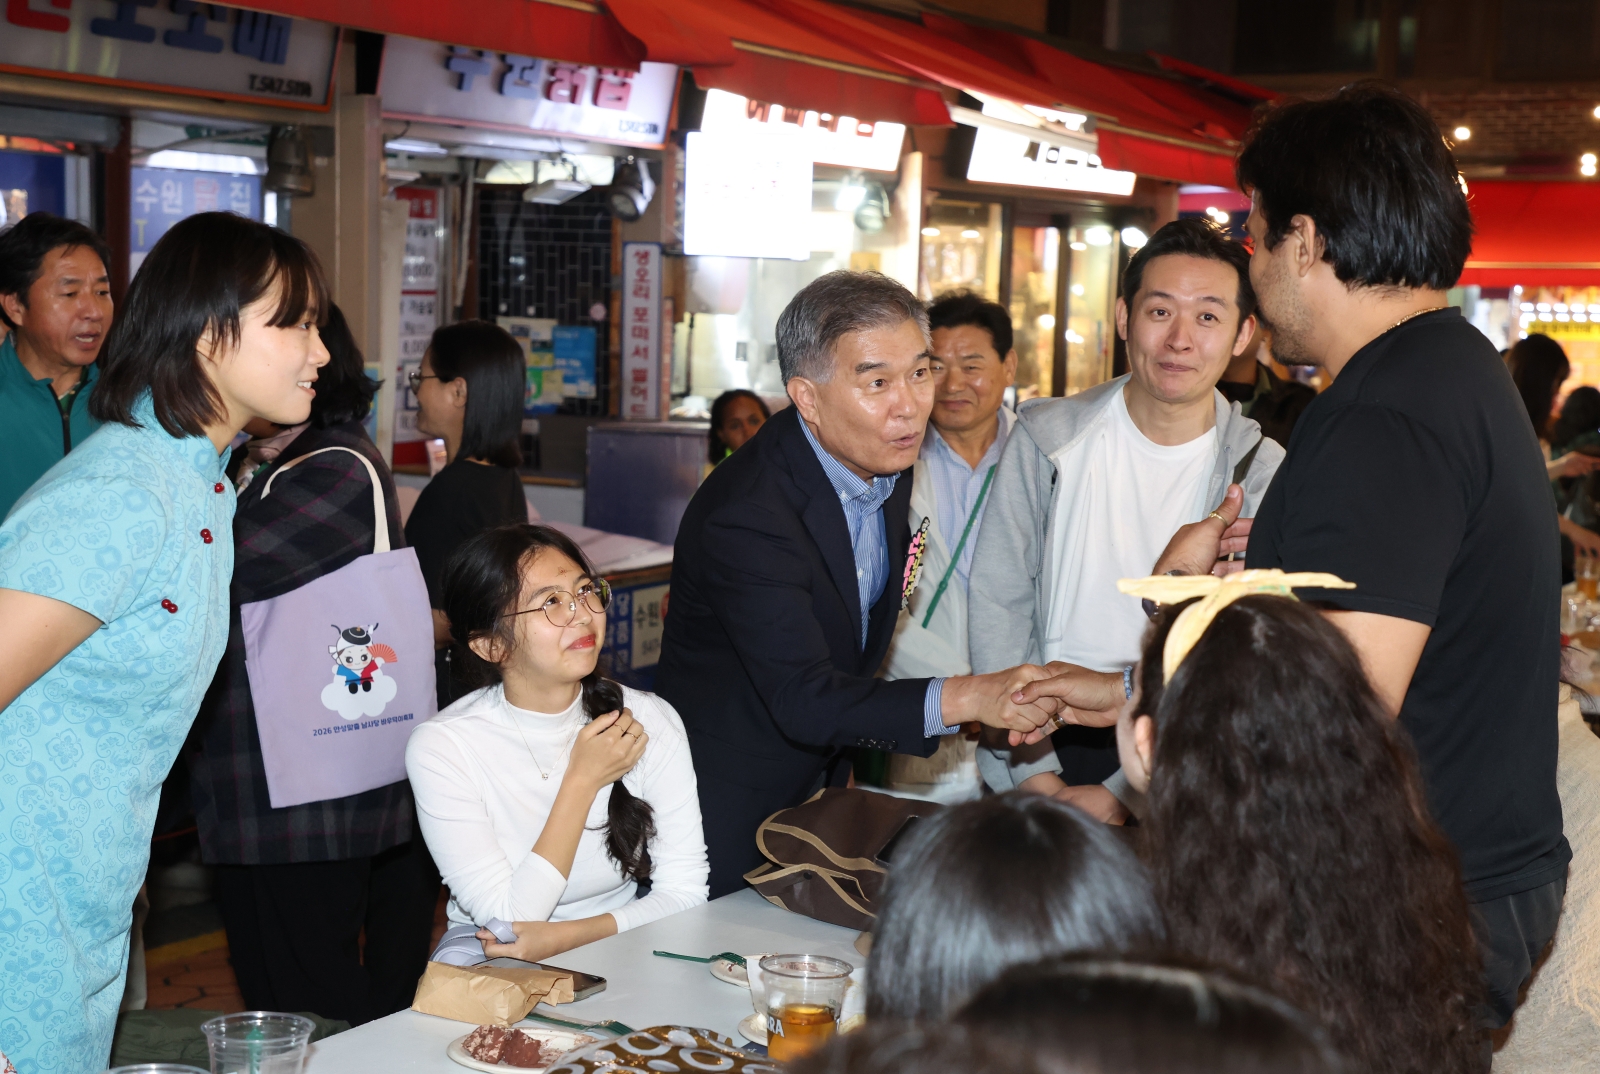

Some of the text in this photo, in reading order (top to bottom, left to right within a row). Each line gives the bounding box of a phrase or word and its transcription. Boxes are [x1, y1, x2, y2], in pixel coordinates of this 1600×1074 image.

[136, 179, 183, 214] 수원
[313, 727, 332, 736] 2026
[361, 720, 379, 729] 남사당
[381, 713, 413, 725] 바우덕이축제
